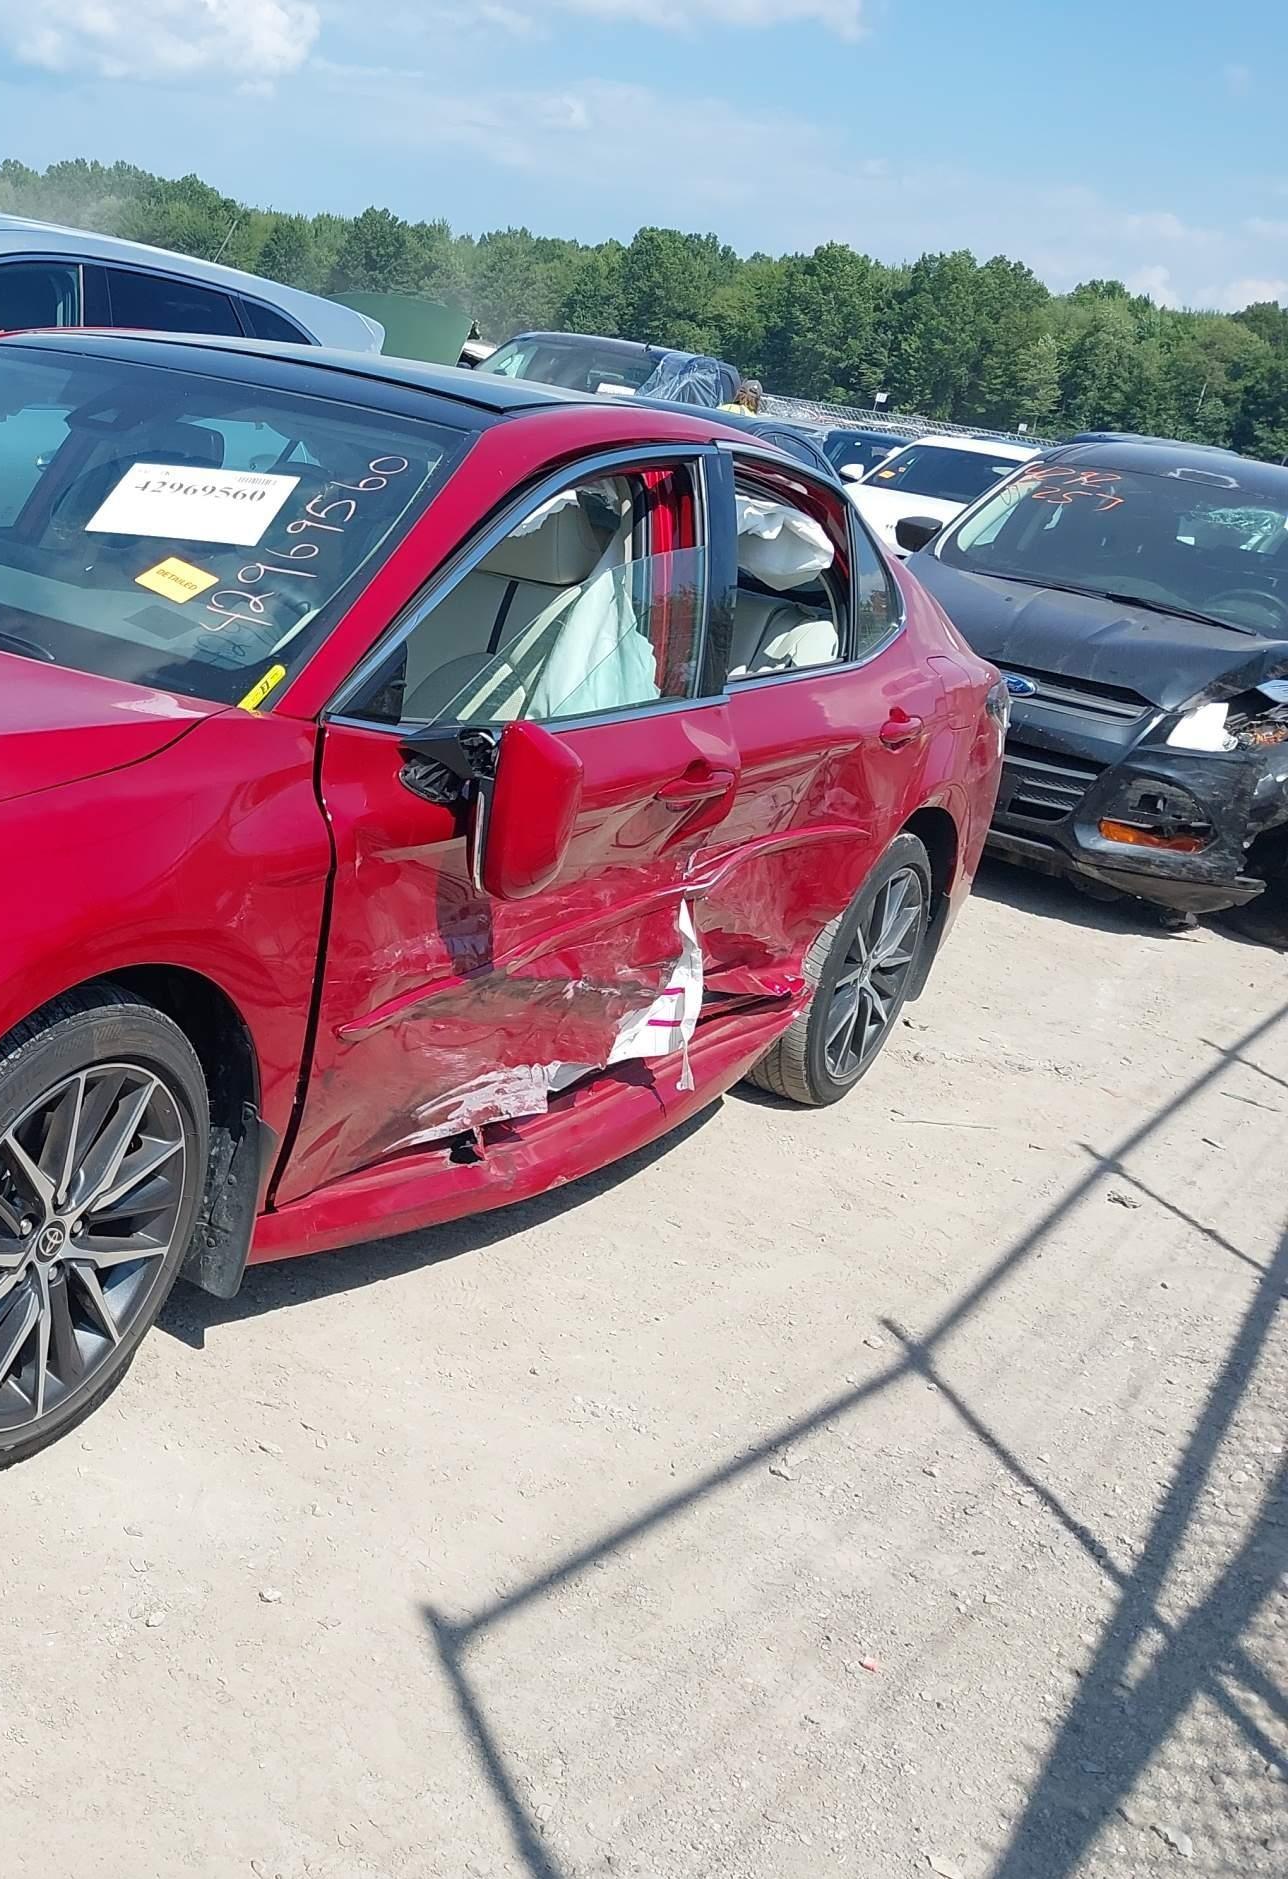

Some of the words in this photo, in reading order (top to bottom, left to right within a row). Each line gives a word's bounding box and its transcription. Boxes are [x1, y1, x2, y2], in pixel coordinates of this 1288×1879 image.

[134, 480, 266, 502] 42969560
[199, 455, 409, 632] 42969560
[155, 568, 199, 591] DETAILED
